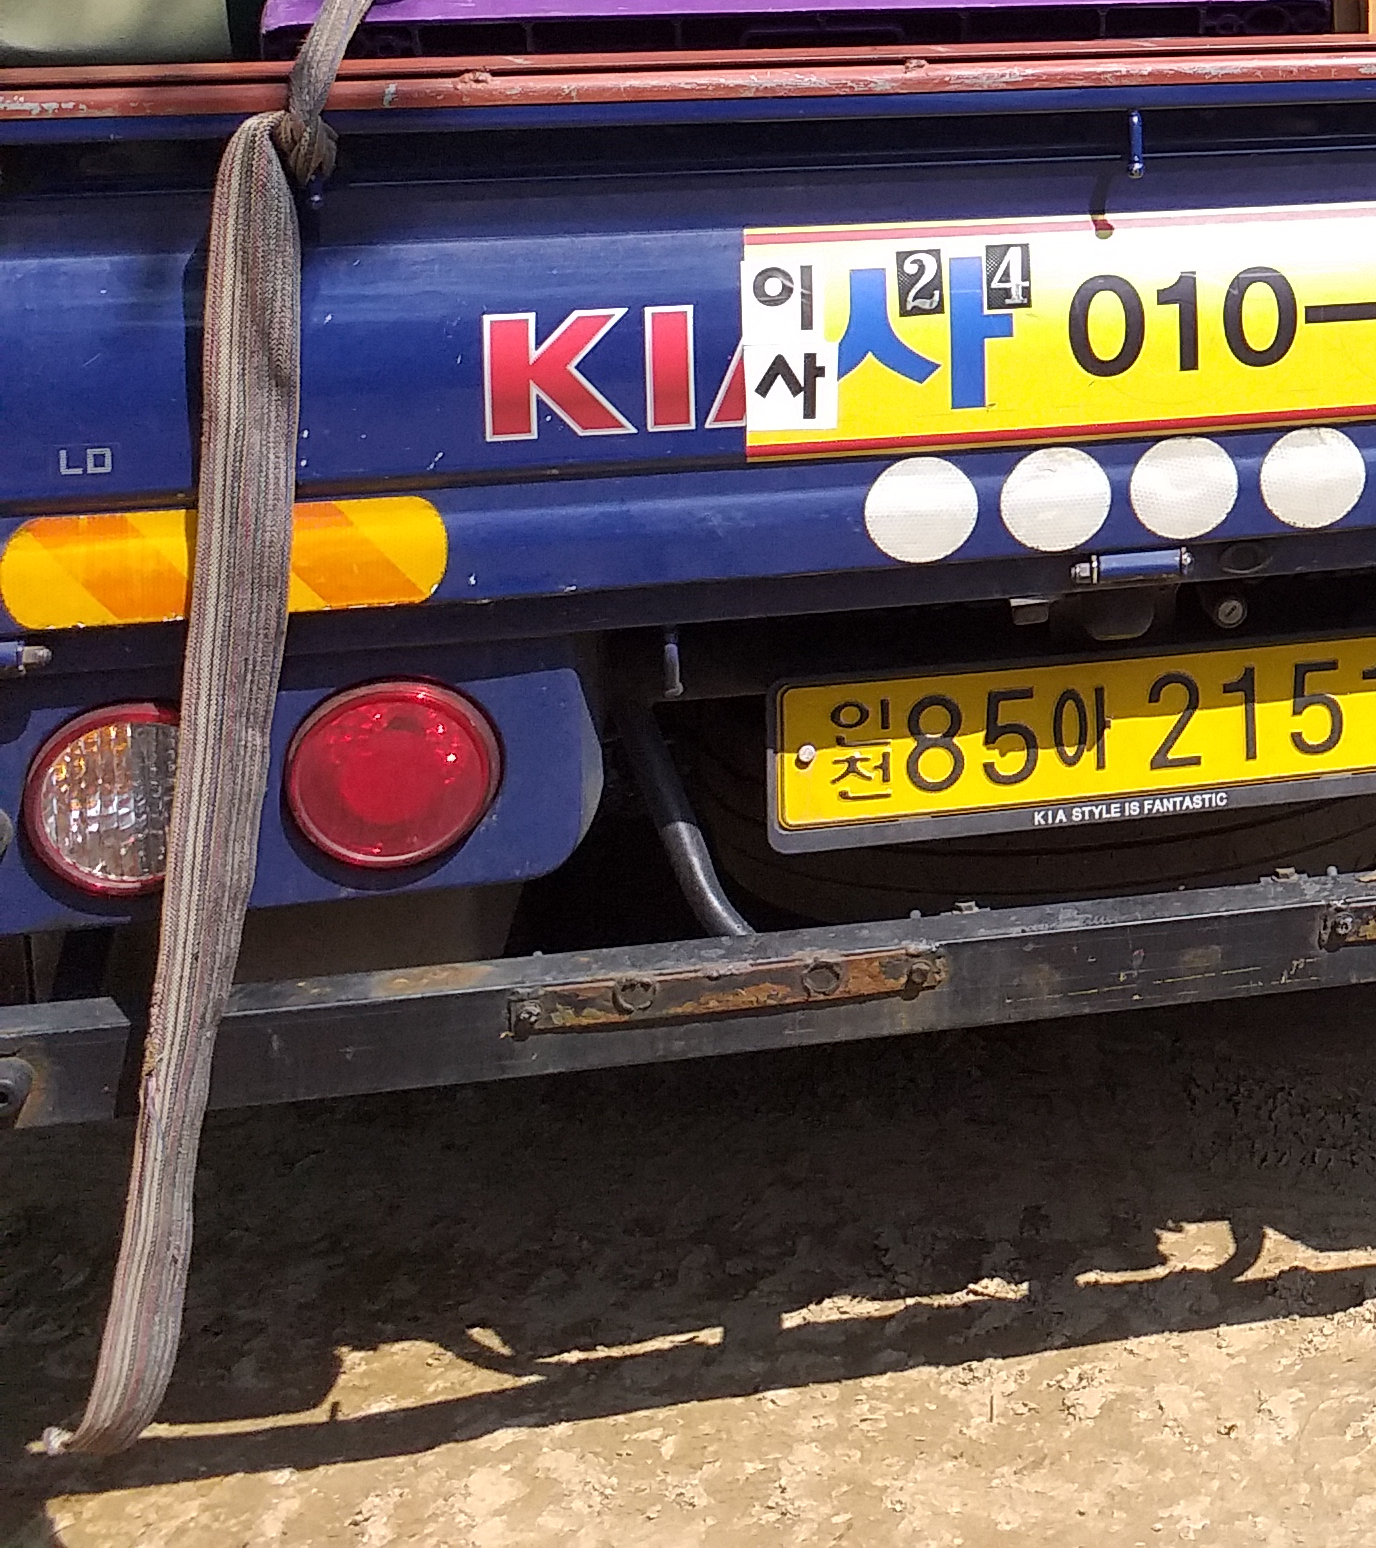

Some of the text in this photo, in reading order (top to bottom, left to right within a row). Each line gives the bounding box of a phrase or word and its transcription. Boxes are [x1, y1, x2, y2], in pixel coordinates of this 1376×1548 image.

[482, 304, 746, 442] KI
[1033, 792, 1229, 826] KIA STYLE IS FANTASTIC
